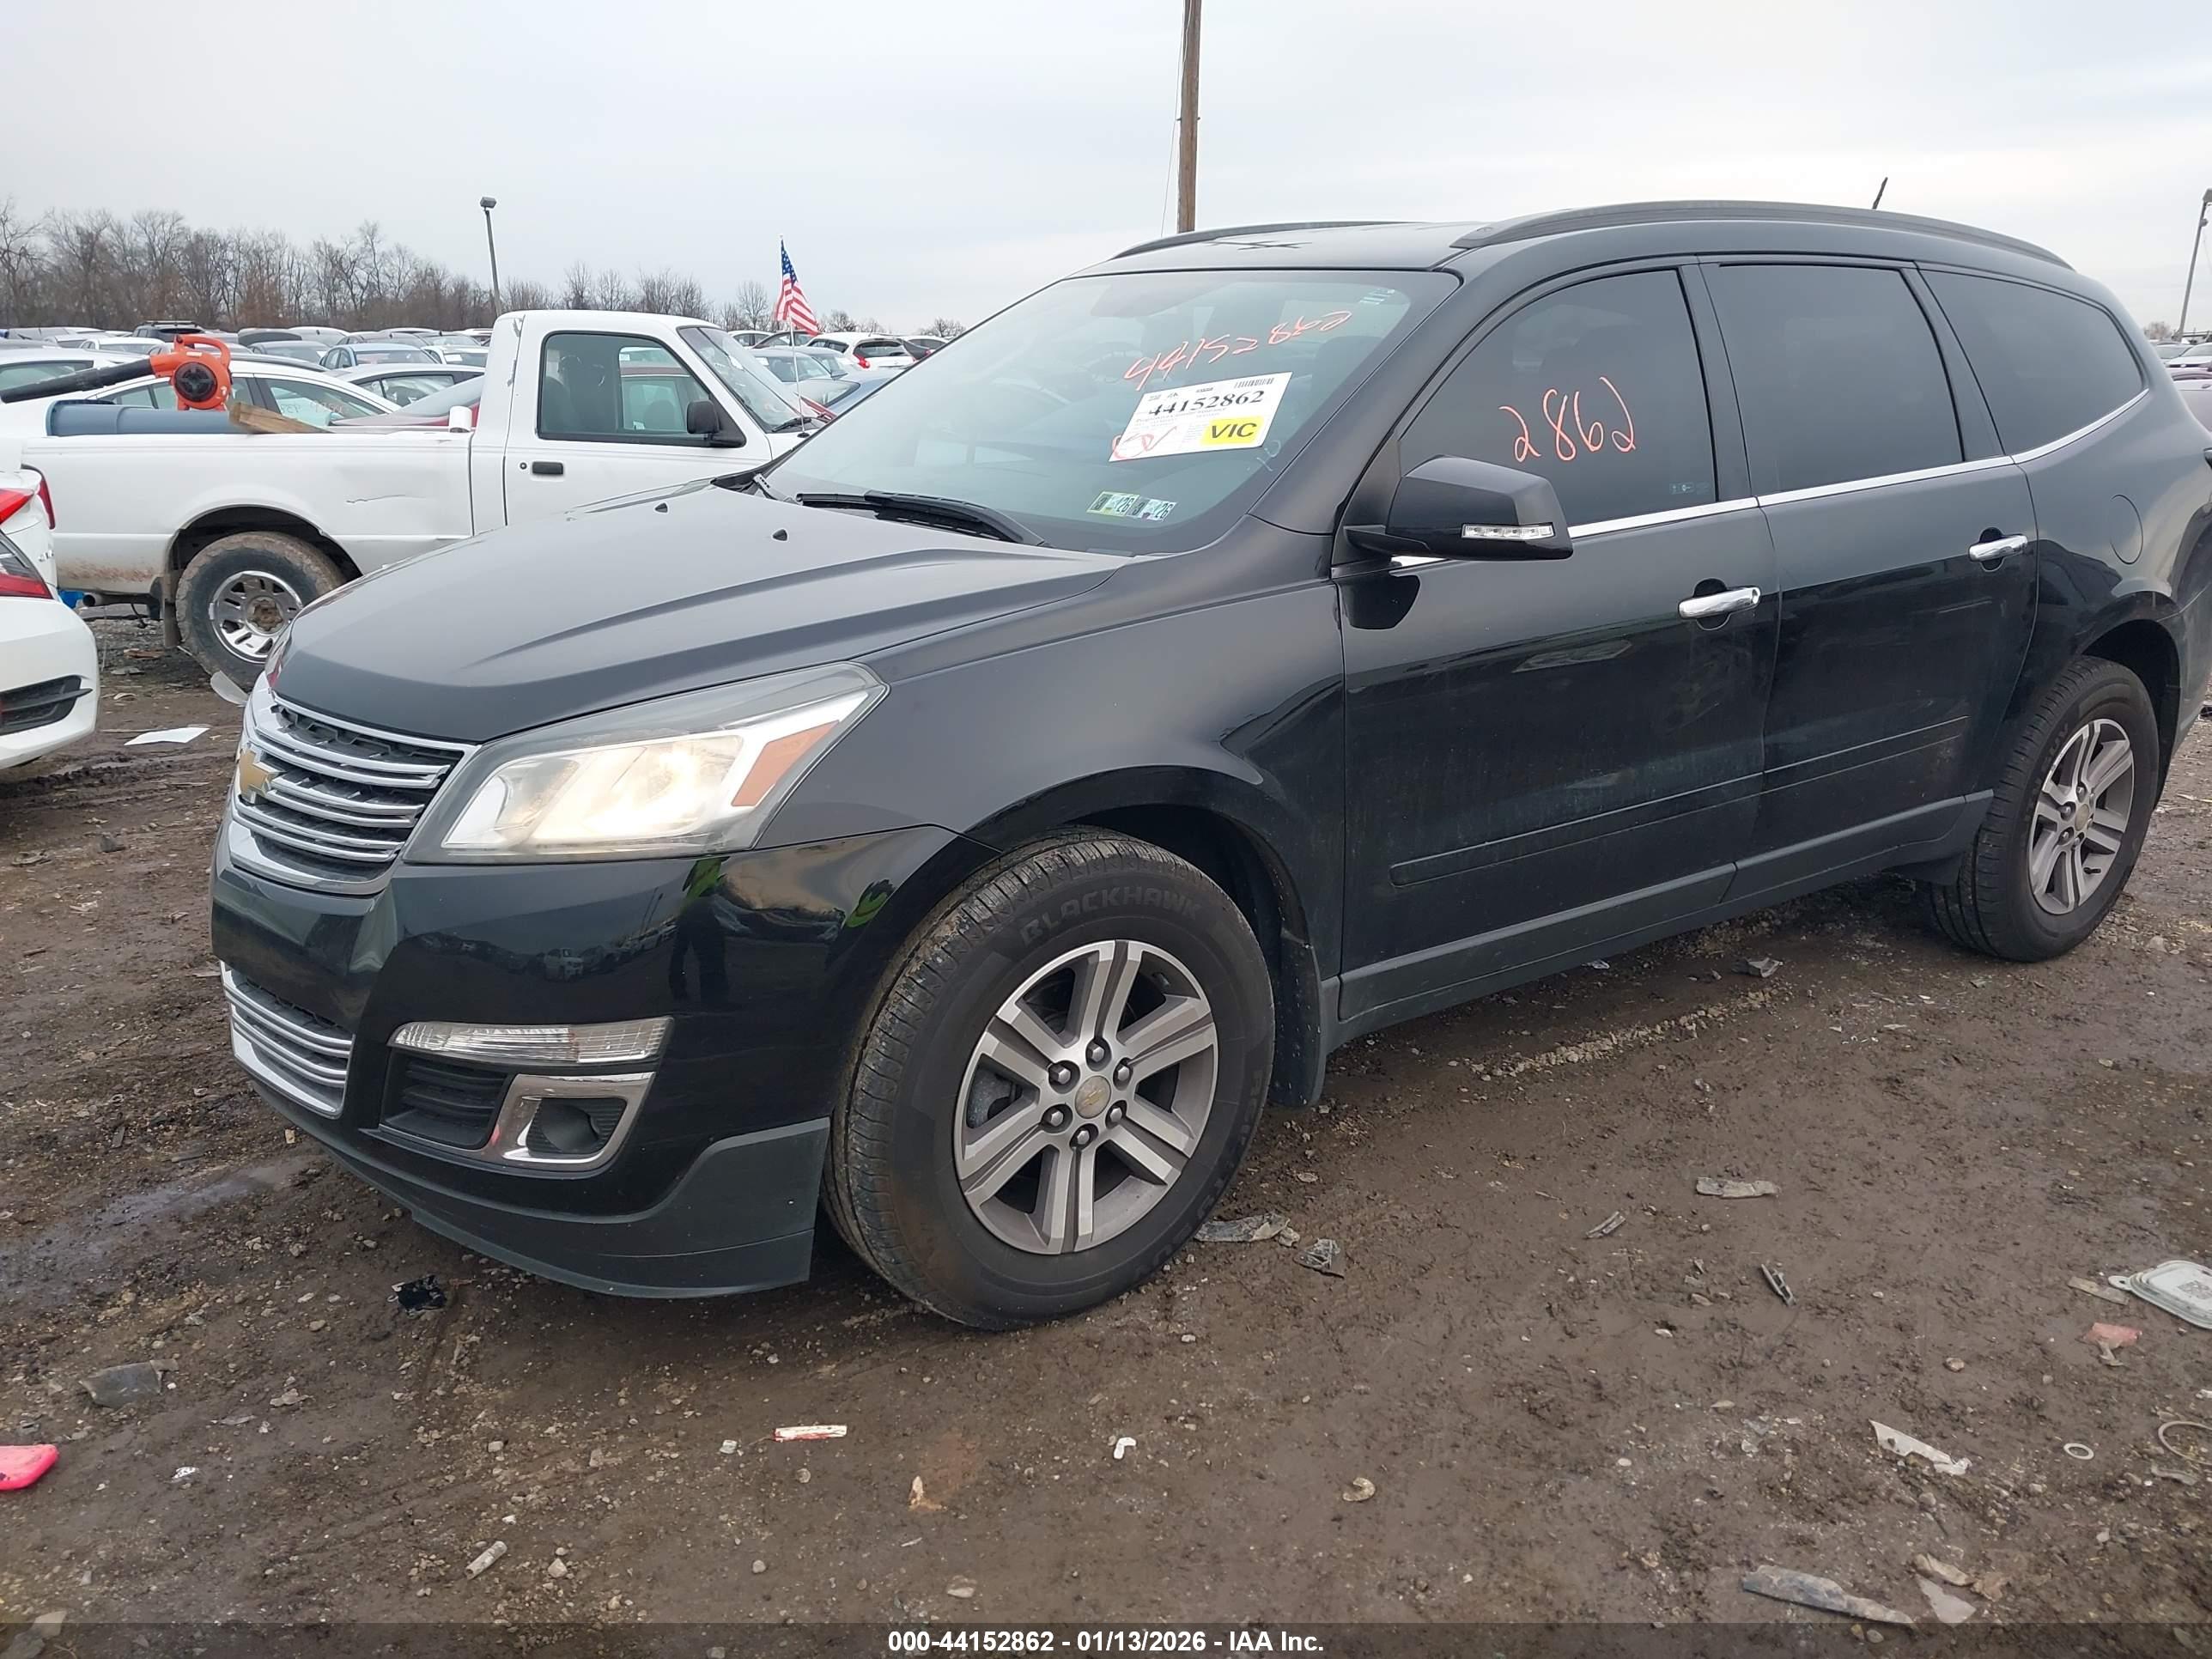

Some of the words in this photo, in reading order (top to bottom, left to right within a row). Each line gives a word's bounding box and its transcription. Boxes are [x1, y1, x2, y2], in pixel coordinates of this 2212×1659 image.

[1148, 390, 1265, 416] 44152862
[1498, 376, 1637, 462] 2862
[1211, 422, 1257, 439] VIC
[1019, 885, 1201, 945] BLACKHAWK
